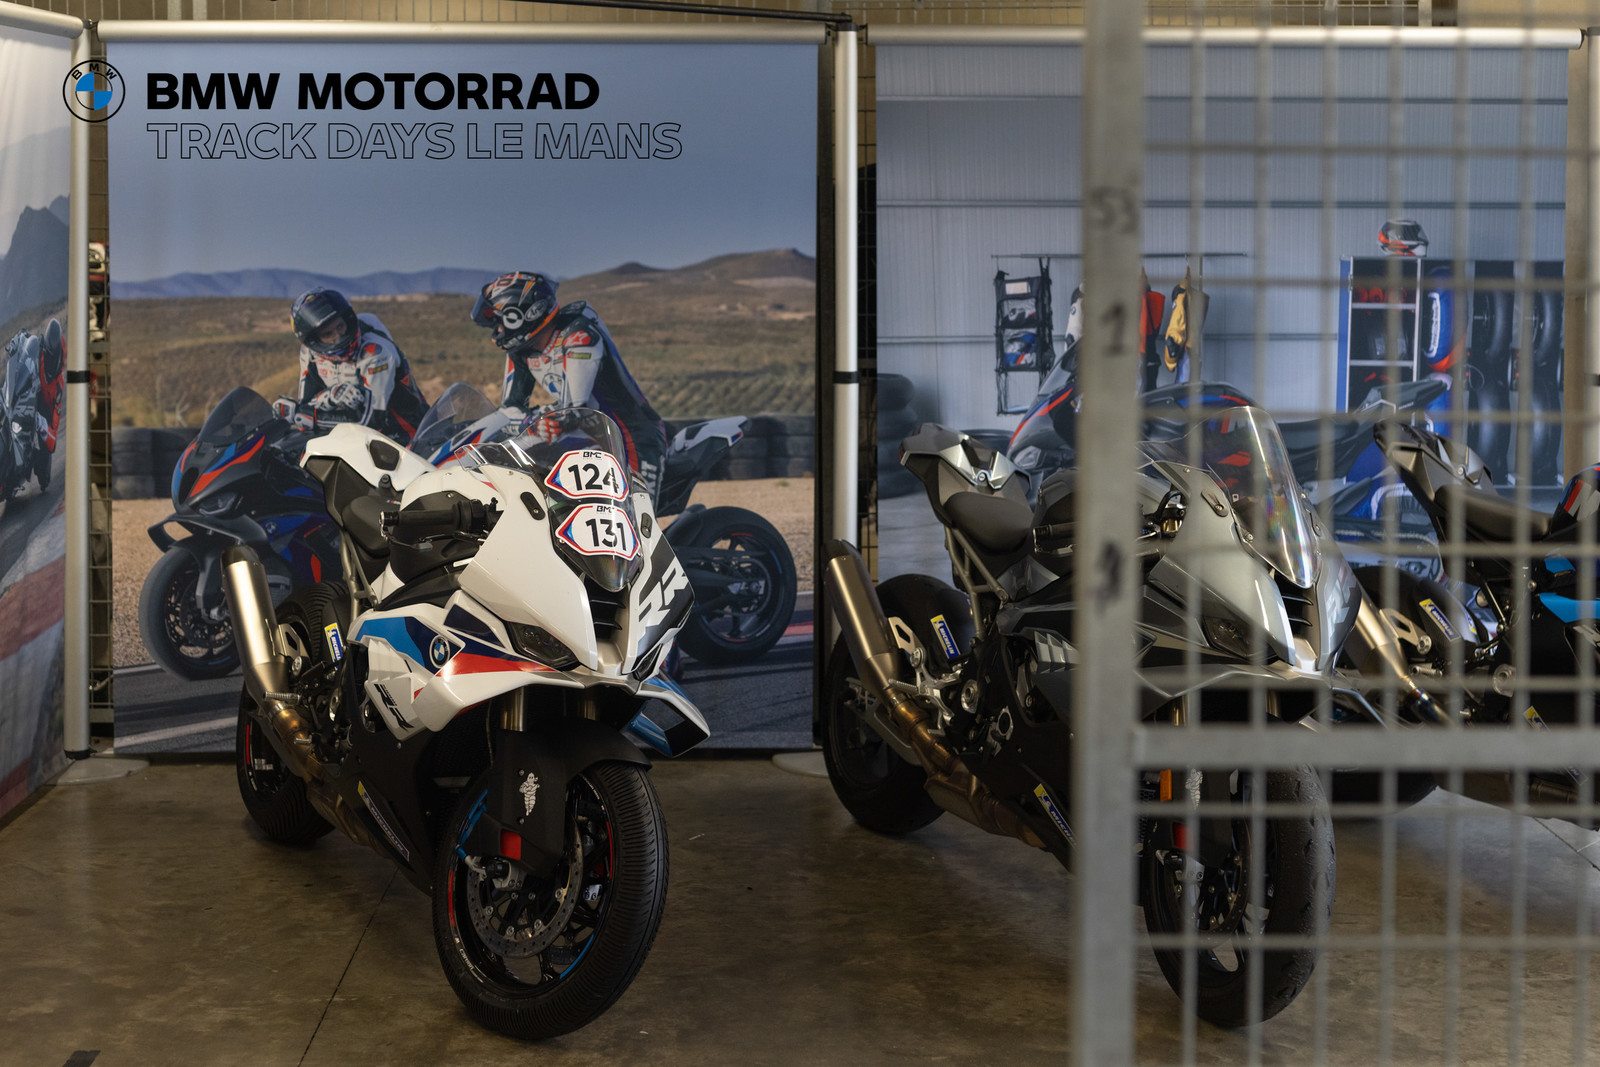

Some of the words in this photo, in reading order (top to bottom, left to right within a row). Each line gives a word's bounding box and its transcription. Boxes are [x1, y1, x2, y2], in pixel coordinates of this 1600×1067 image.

[583, 451, 602, 459] BMC
[568, 463, 619, 494] 124
[585, 518, 627, 551] 131
[939, 627, 955, 655] MICHELIN
